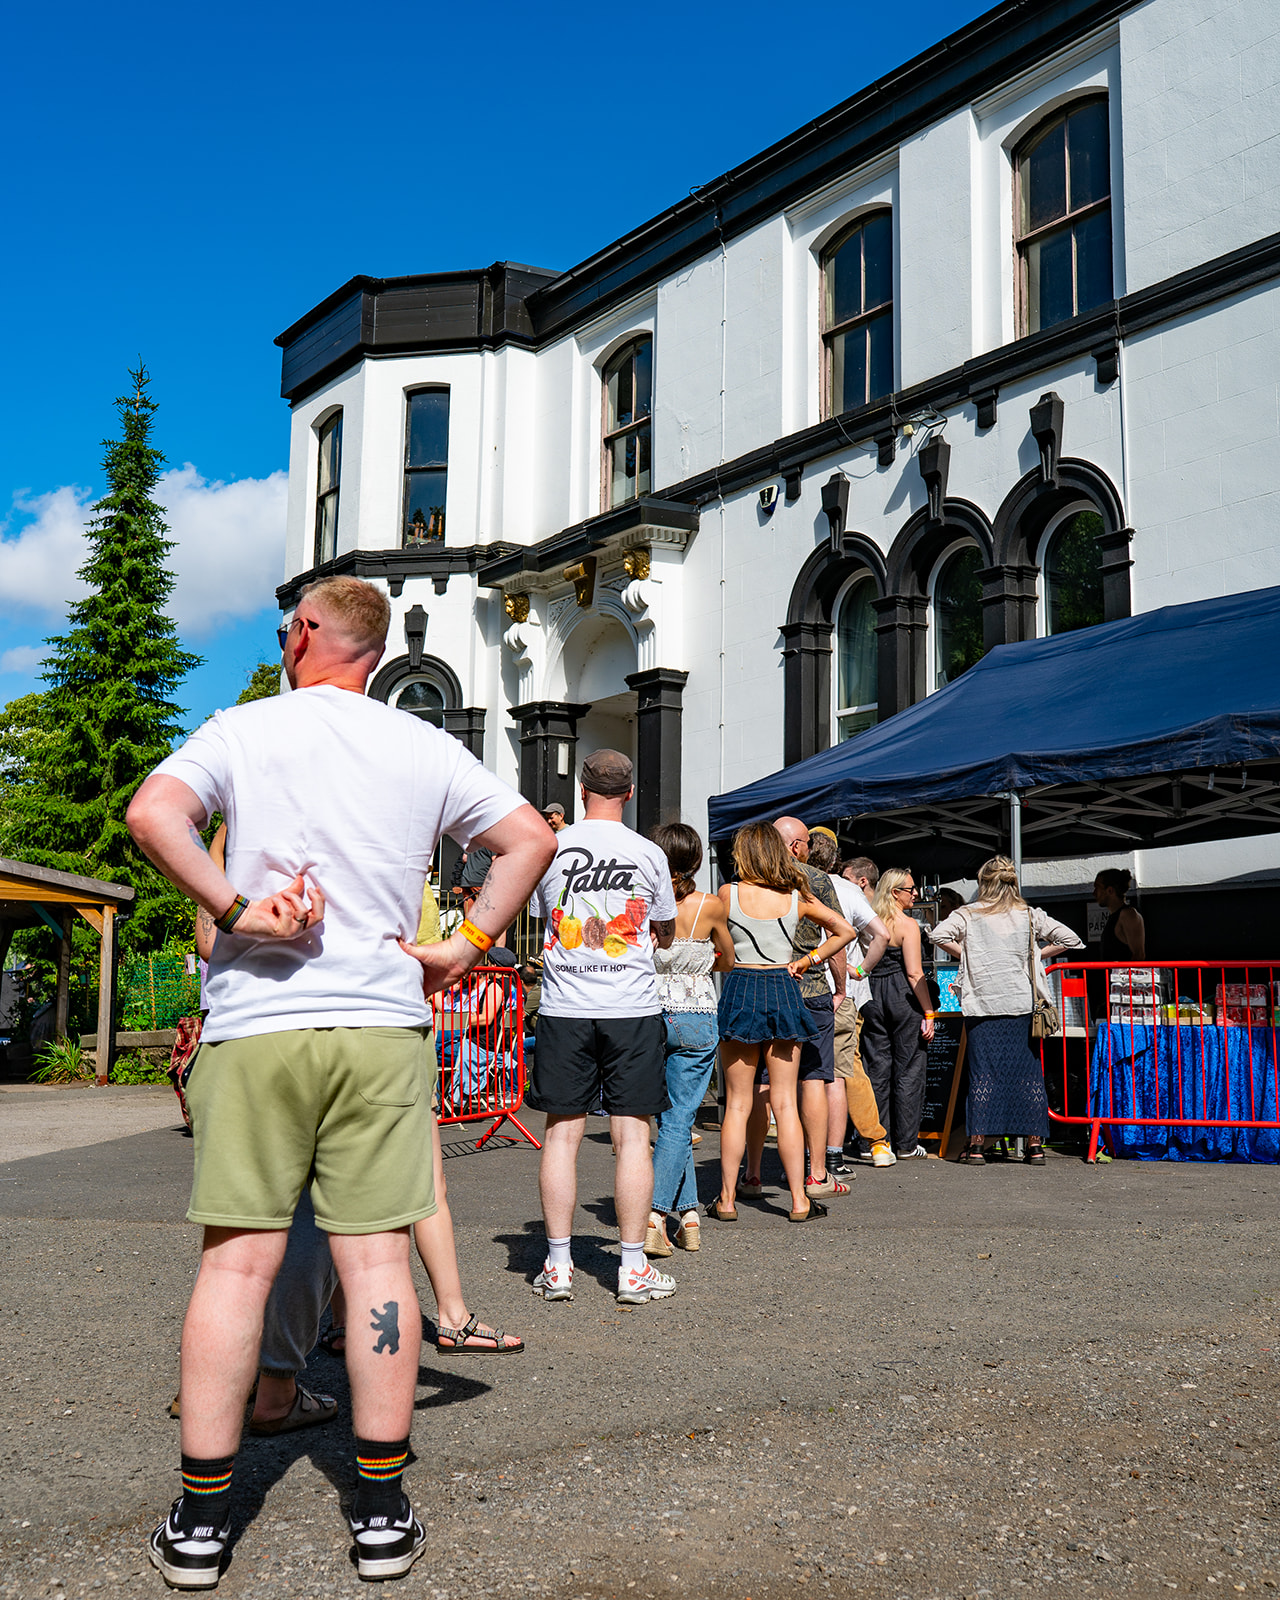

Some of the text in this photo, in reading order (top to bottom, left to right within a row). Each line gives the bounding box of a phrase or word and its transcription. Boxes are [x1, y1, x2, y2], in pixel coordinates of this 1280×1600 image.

[556, 847, 638, 906] Patta
[555, 964, 578, 974] SOME
[579, 964, 598, 973] LIKE
[610, 964, 628, 972] HOT
[369, 1516, 388, 1528] NIKE
[191, 1526, 214, 1538] NIKE
